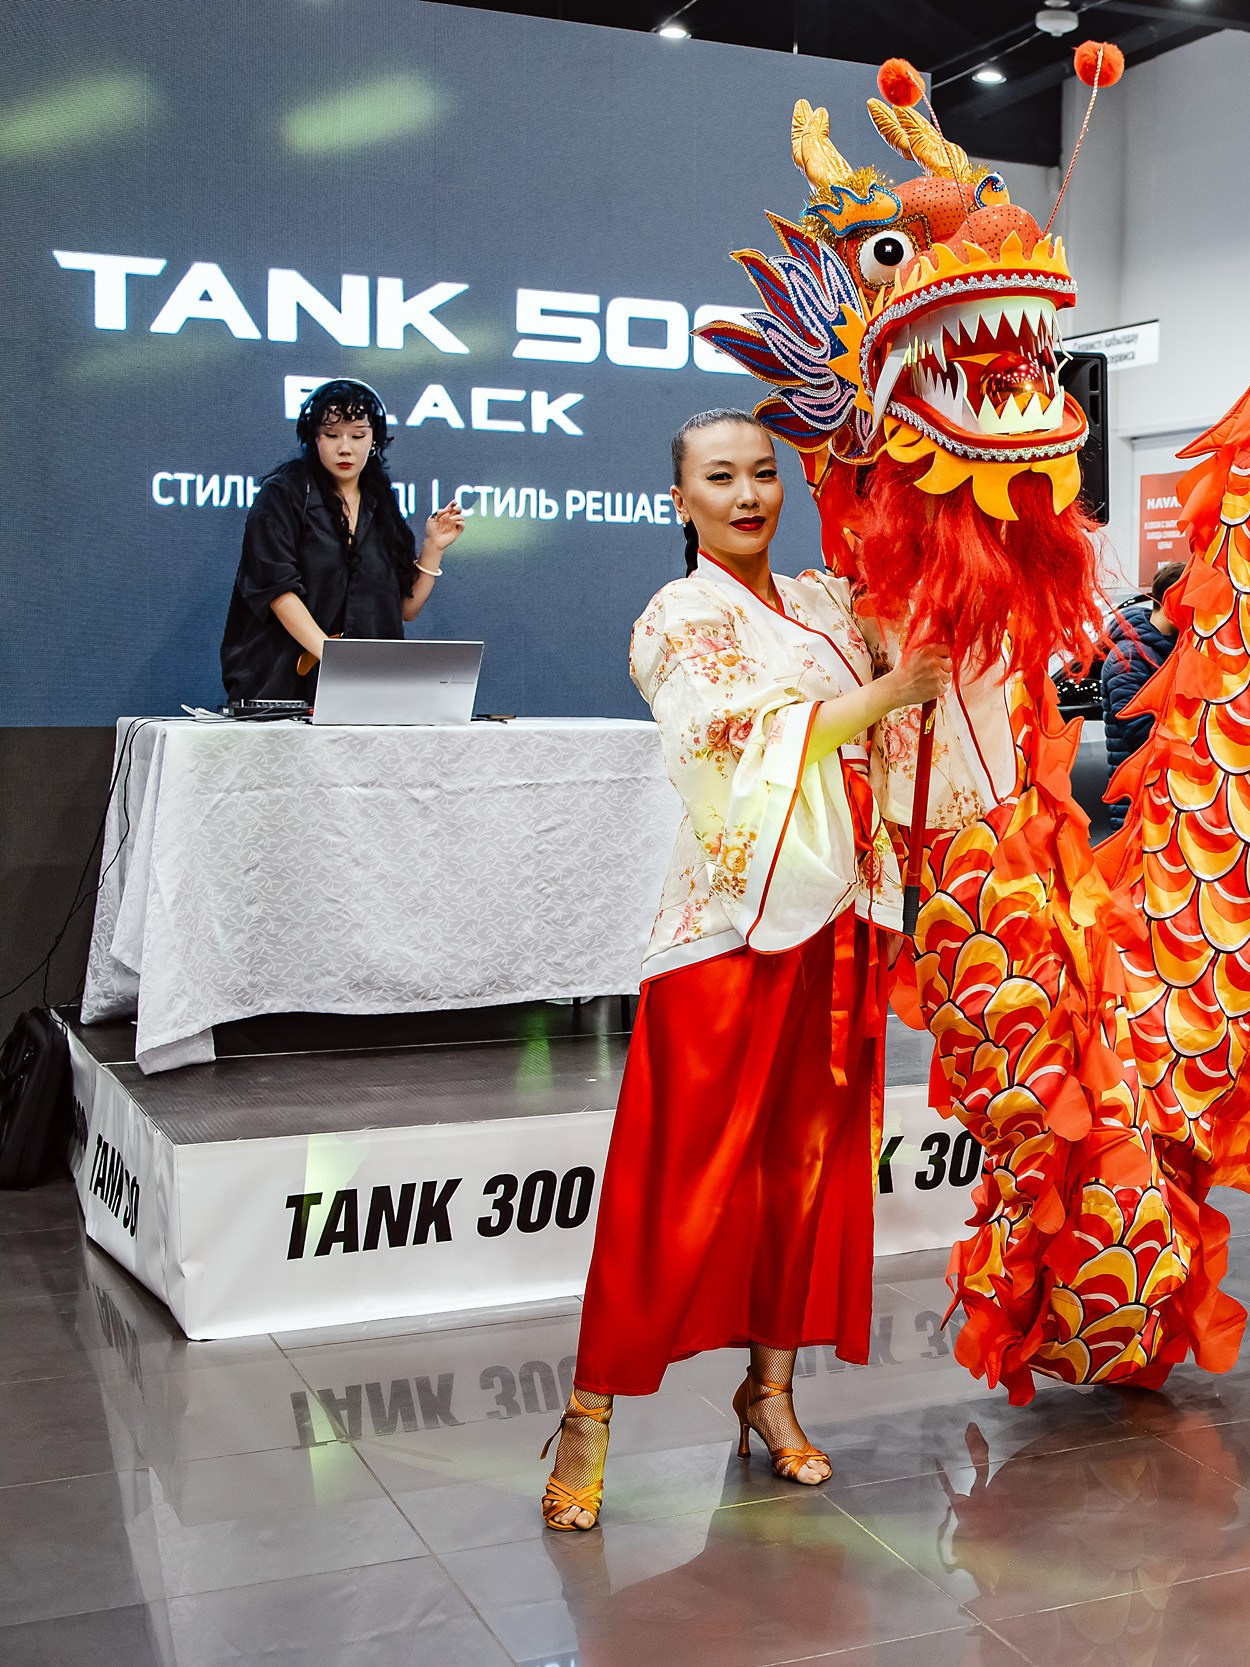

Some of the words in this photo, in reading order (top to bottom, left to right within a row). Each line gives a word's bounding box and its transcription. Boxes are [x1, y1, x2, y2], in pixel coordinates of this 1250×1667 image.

[52, 250, 470, 355] TANK
[284, 375, 584, 435] ACK
[455, 484, 559, 520] СТИЛЬ
[566, 489, 680, 524] РЕШАЕ
[1147, 496, 1182, 510] HAVA
[914, 1130, 984, 1191] 30
[285, 1178, 463, 1261] TANK
[477, 1165, 595, 1239] 300
